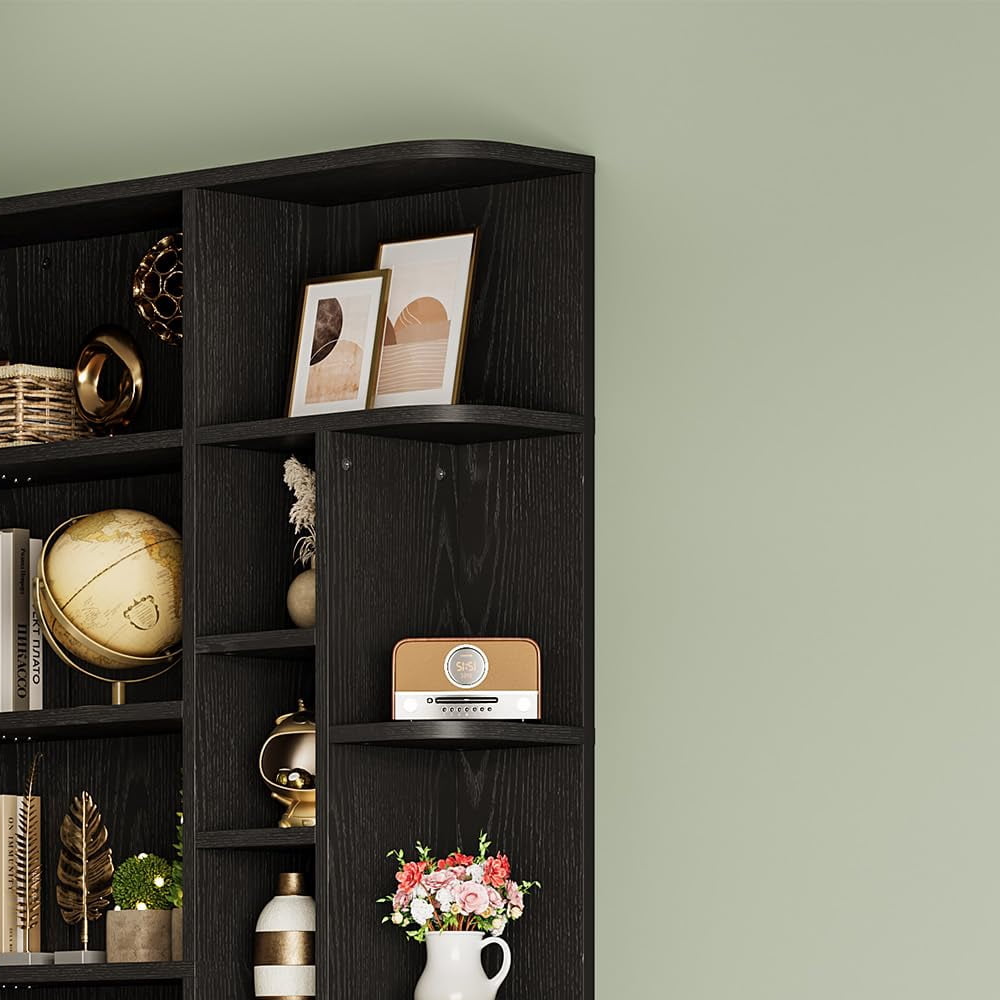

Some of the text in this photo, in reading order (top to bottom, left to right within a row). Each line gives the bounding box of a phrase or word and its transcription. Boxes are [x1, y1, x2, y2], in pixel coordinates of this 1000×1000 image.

[17, 624, 27, 698] ПИКАССО
[32, 640, 40, 684] ПЛАТО
[8, 817, 14, 830] ON
